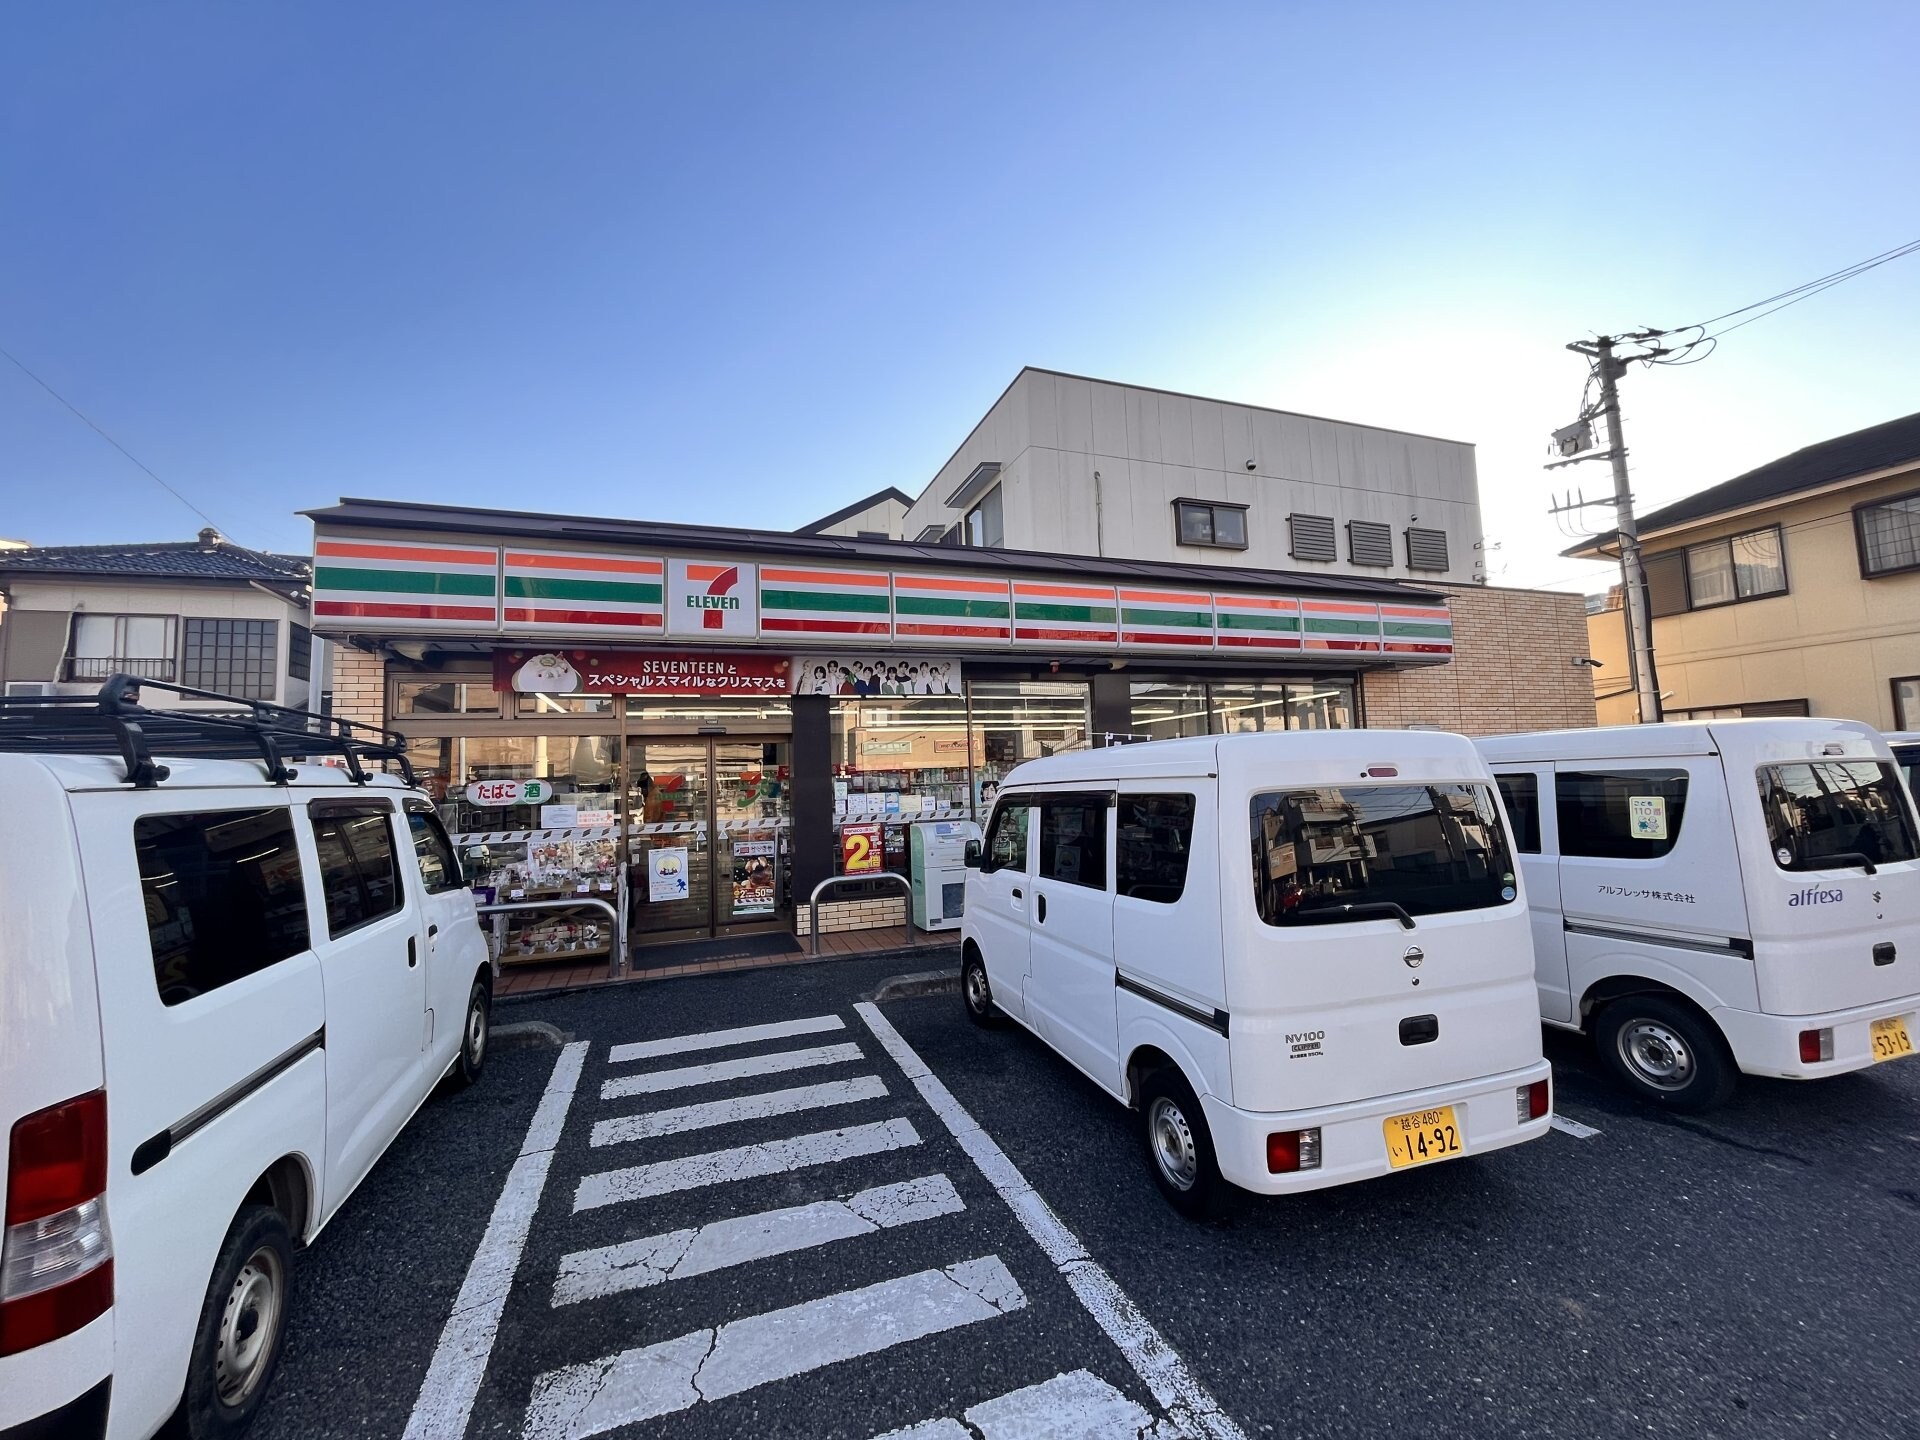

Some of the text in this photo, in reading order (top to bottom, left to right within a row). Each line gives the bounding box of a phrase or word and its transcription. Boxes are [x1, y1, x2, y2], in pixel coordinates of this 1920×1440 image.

[477, 783, 541, 799] たばこ 酒
[1598, 885, 1696, 904] アルフレッサ株式会社
[1788, 883, 1843, 907] alfresa
[1285, 1030, 1326, 1044] NV100
[1401, 1111, 1440, 1131] 越谷 480
[1392, 1125, 1459, 1160] い 14-92
